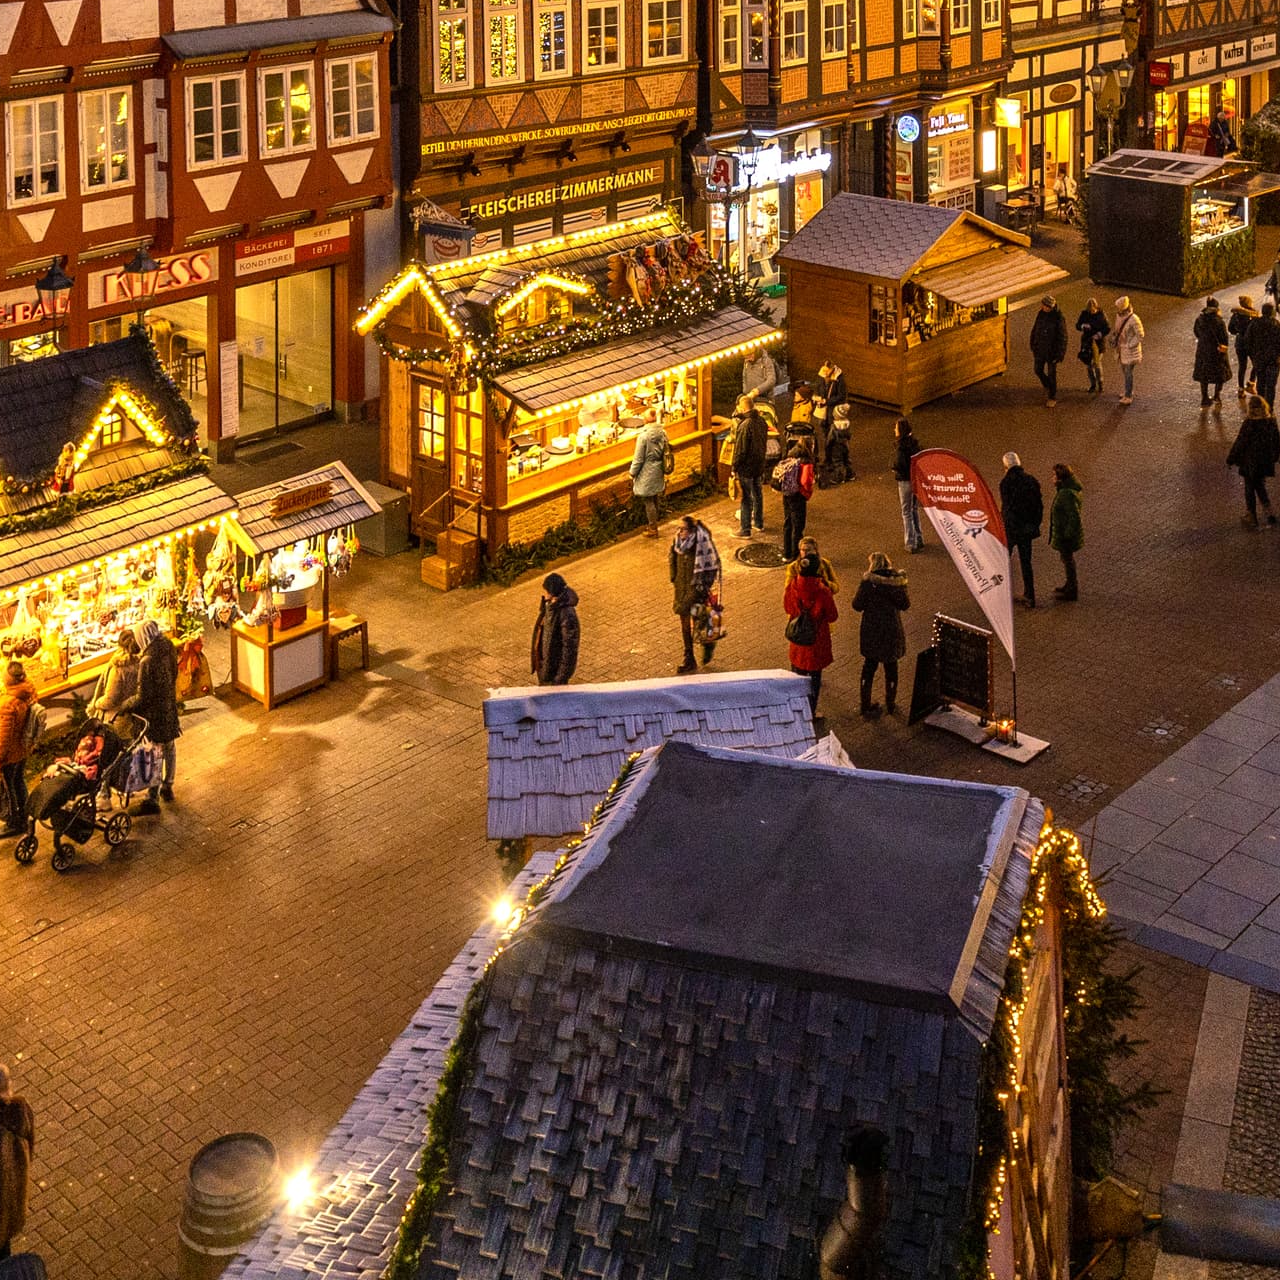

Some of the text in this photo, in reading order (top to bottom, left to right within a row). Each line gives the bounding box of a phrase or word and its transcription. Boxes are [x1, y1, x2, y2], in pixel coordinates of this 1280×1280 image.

[1223, 47, 1244, 60] VATTER
[464, 136, 490, 149] HERRN
[471, 168, 654, 218] FLEISCHEREI ZIMMERMANN
[313, 227, 332, 238] SEIT
[312, 243, 333, 255] 1871
[239, 253, 292, 271] KONDITOREI
